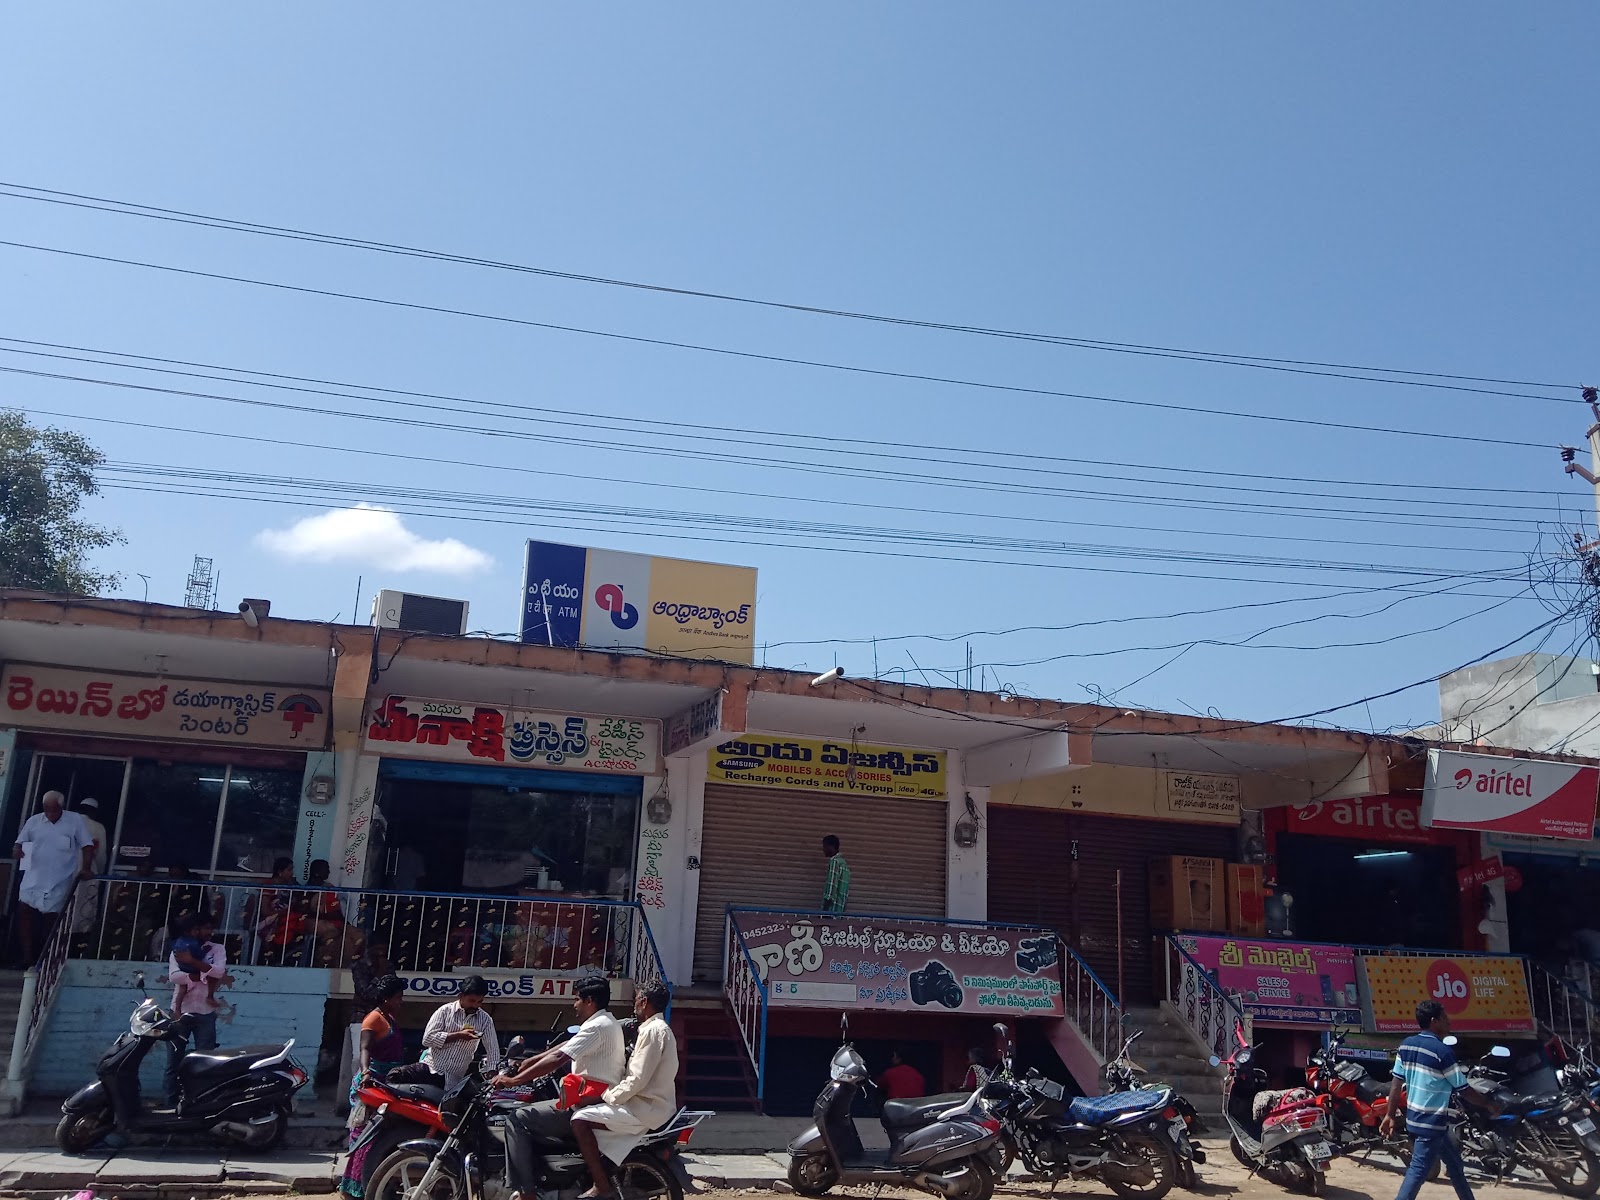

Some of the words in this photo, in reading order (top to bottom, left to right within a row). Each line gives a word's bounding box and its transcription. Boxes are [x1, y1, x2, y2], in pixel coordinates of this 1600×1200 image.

[558, 606, 578, 618] ATM
[423, 702, 462, 717] మధుర
[180, 714, 249, 736] సెంటర్
[722, 759, 760, 769] SAMSUNG
[768, 764, 811, 775] MOBILES
[815, 766, 822, 775] &
[825, 768, 892, 782] ACCSORIES
[725, 771, 781, 784] Recharge
[785, 776, 820, 787] Cords
[823, 779, 844, 789] and
[848, 782, 894, 794] V-Topup
[921, 788, 934, 796] 4G
[1476, 768, 1532, 797] airtel
[940, 933, 956, 953] &
[1219, 940, 1243, 968] శ్రీ
[1246, 944, 1318, 975] మొబైల్స్
[540, 978, 579, 996] AT
[963, 977, 970, 987] 5
[1257, 976, 1280, 987] SALES
[1281, 978, 1290, 987] &
[1432, 973, 1467, 999] Jio
[1473, 976, 1509, 987] DIGITAL
[1258, 988, 1291, 998] SERVICE
[1475, 987, 1495, 998] LIFE
